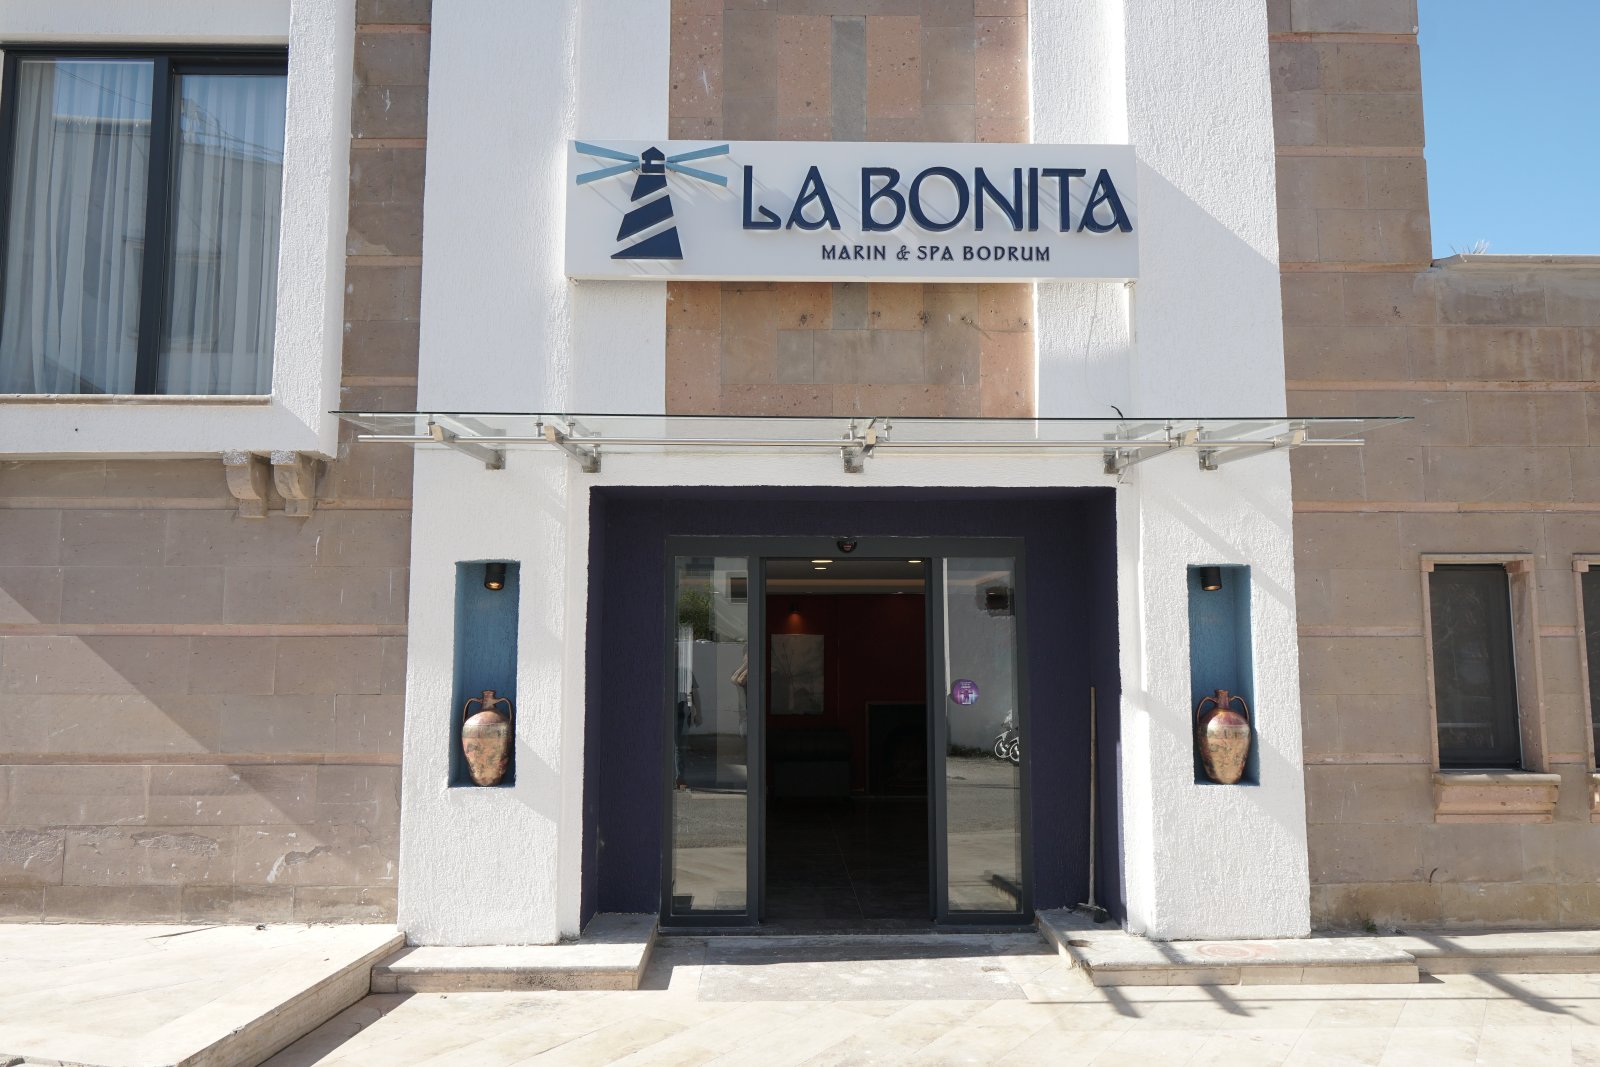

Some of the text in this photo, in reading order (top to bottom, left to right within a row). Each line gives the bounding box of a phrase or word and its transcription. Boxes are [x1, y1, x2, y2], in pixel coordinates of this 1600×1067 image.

[742, 165, 1134, 234] LA BONITA
[821, 244, 1051, 262] MARIN & SPA BODRUM
